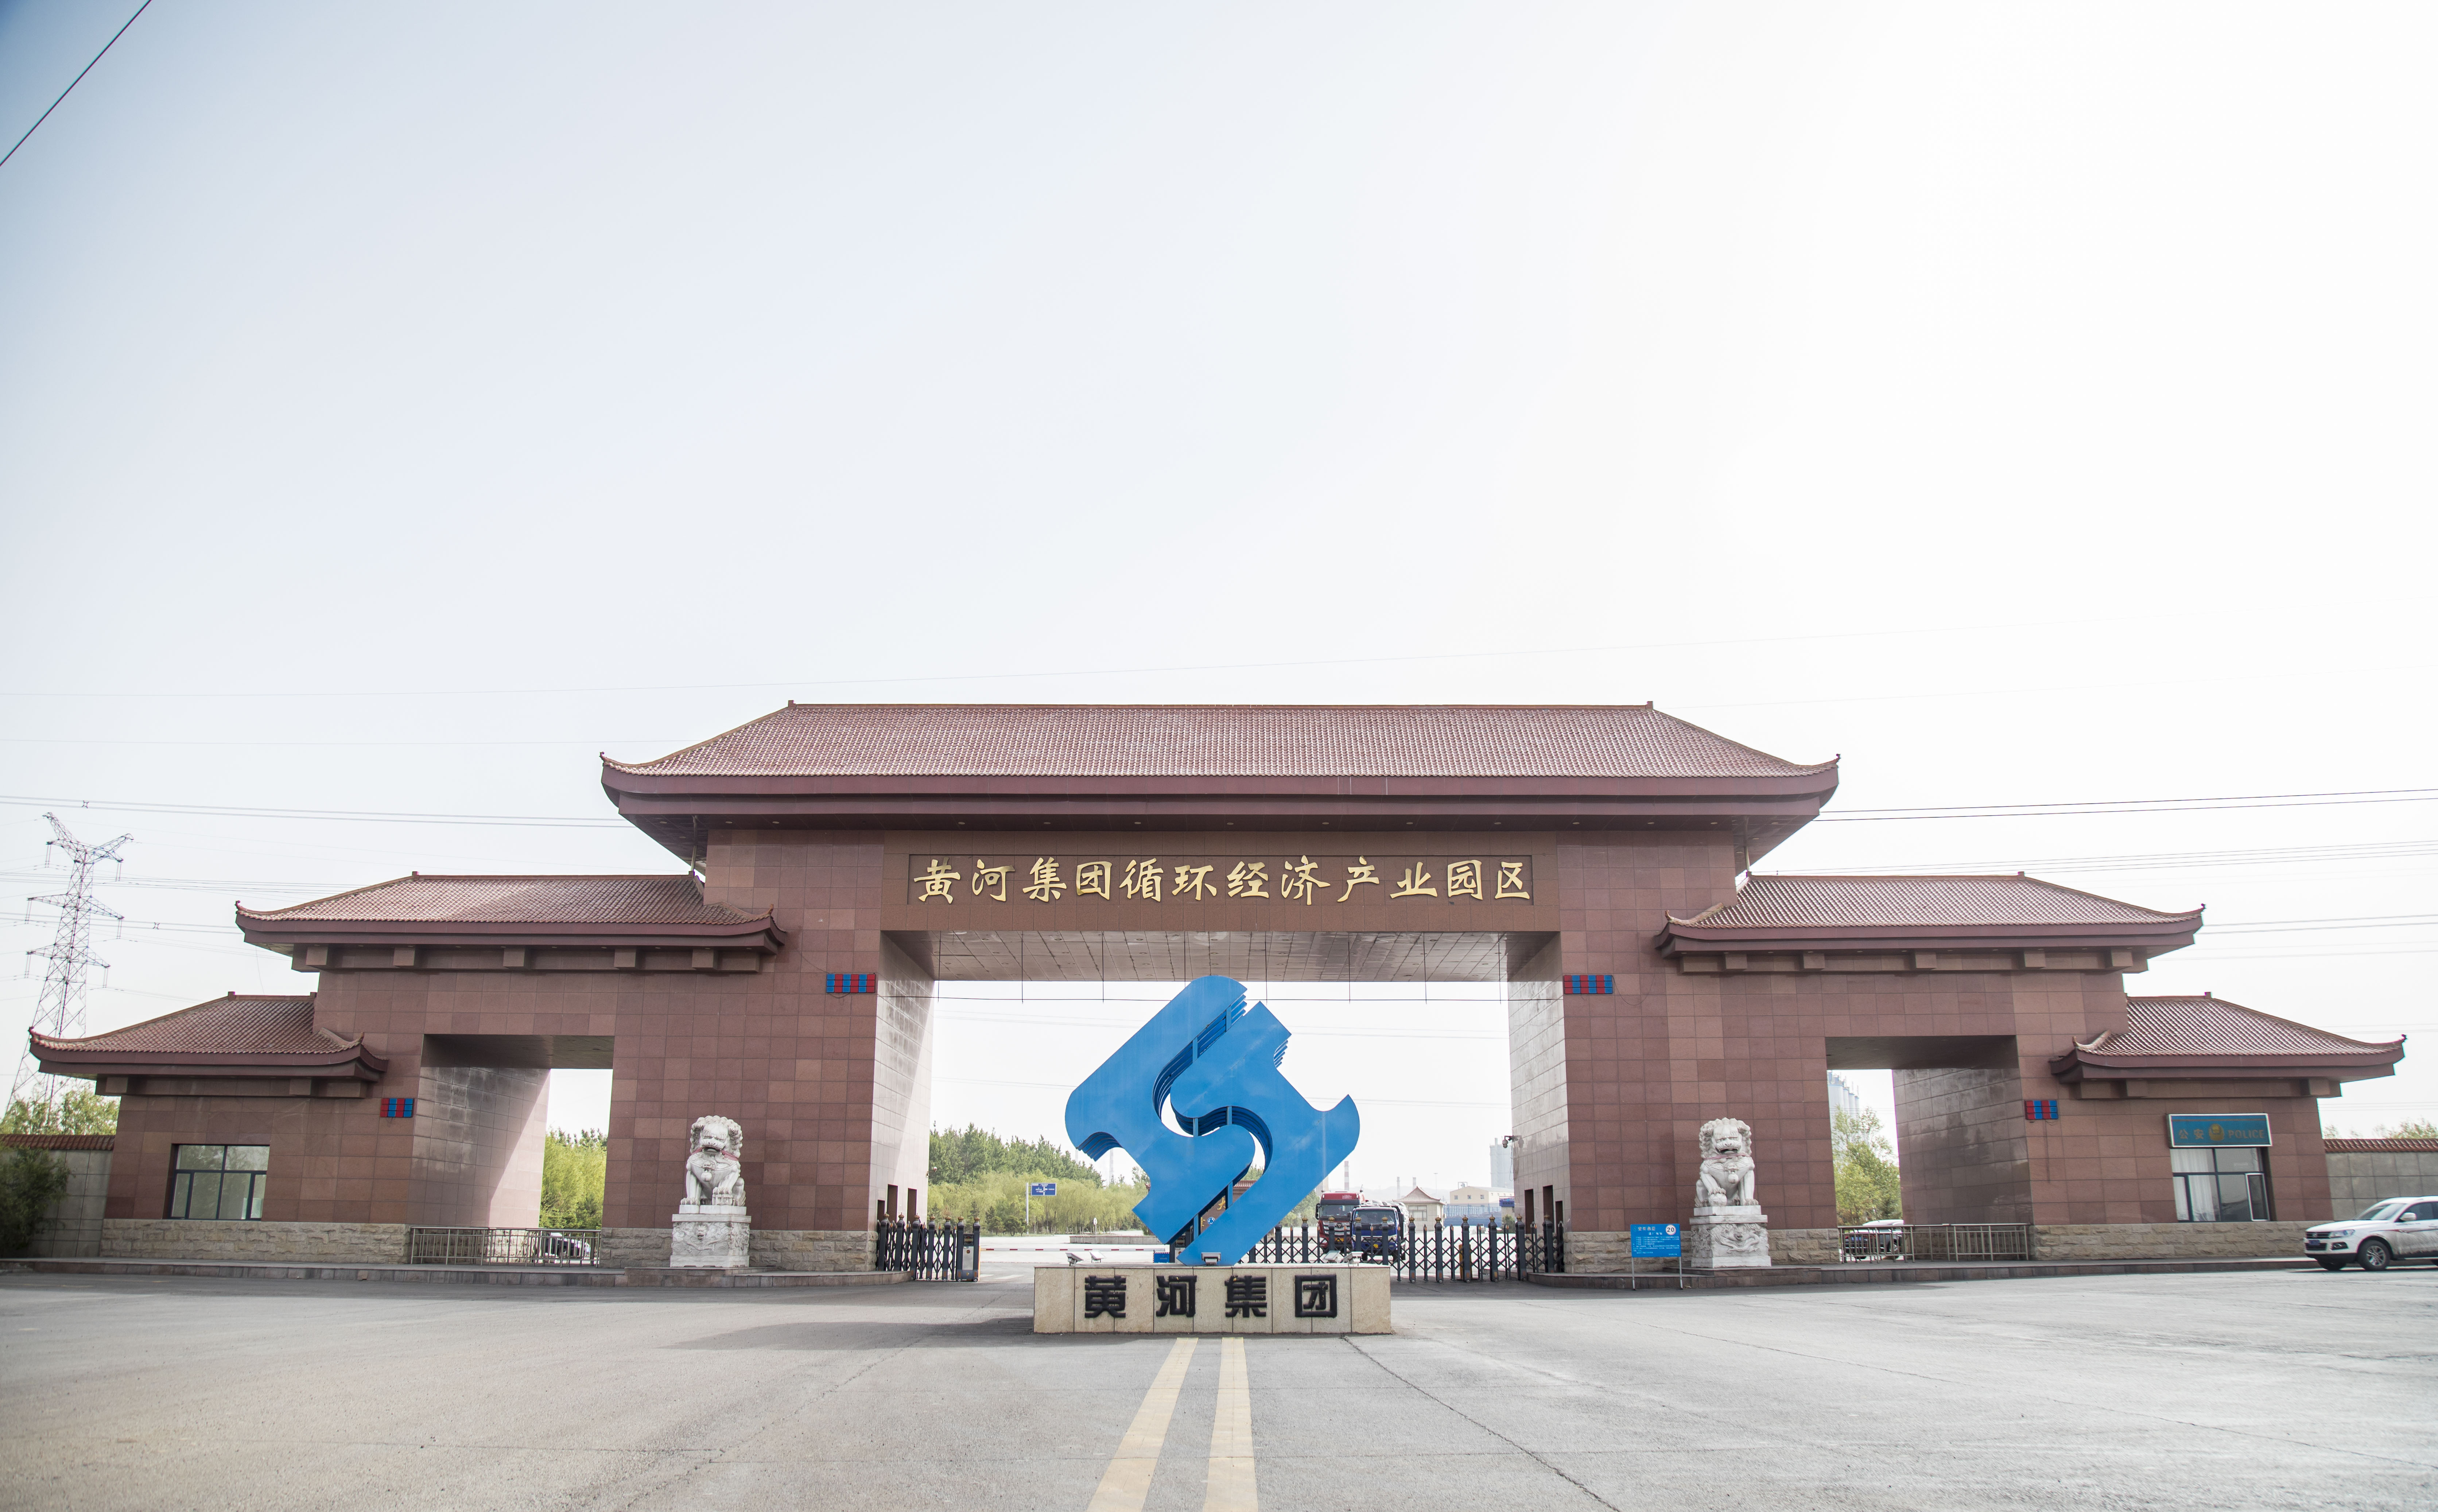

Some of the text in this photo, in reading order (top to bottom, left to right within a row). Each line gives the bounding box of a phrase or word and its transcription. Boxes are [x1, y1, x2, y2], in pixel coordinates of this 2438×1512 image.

[913, 855, 1530, 905] 黄河集团循环经济产业园区
[2178, 1128, 2204, 1140] 公安
[2228, 1129, 2264, 1139] POLICE
[1084, 1275, 1338, 1318] 黄河集团
